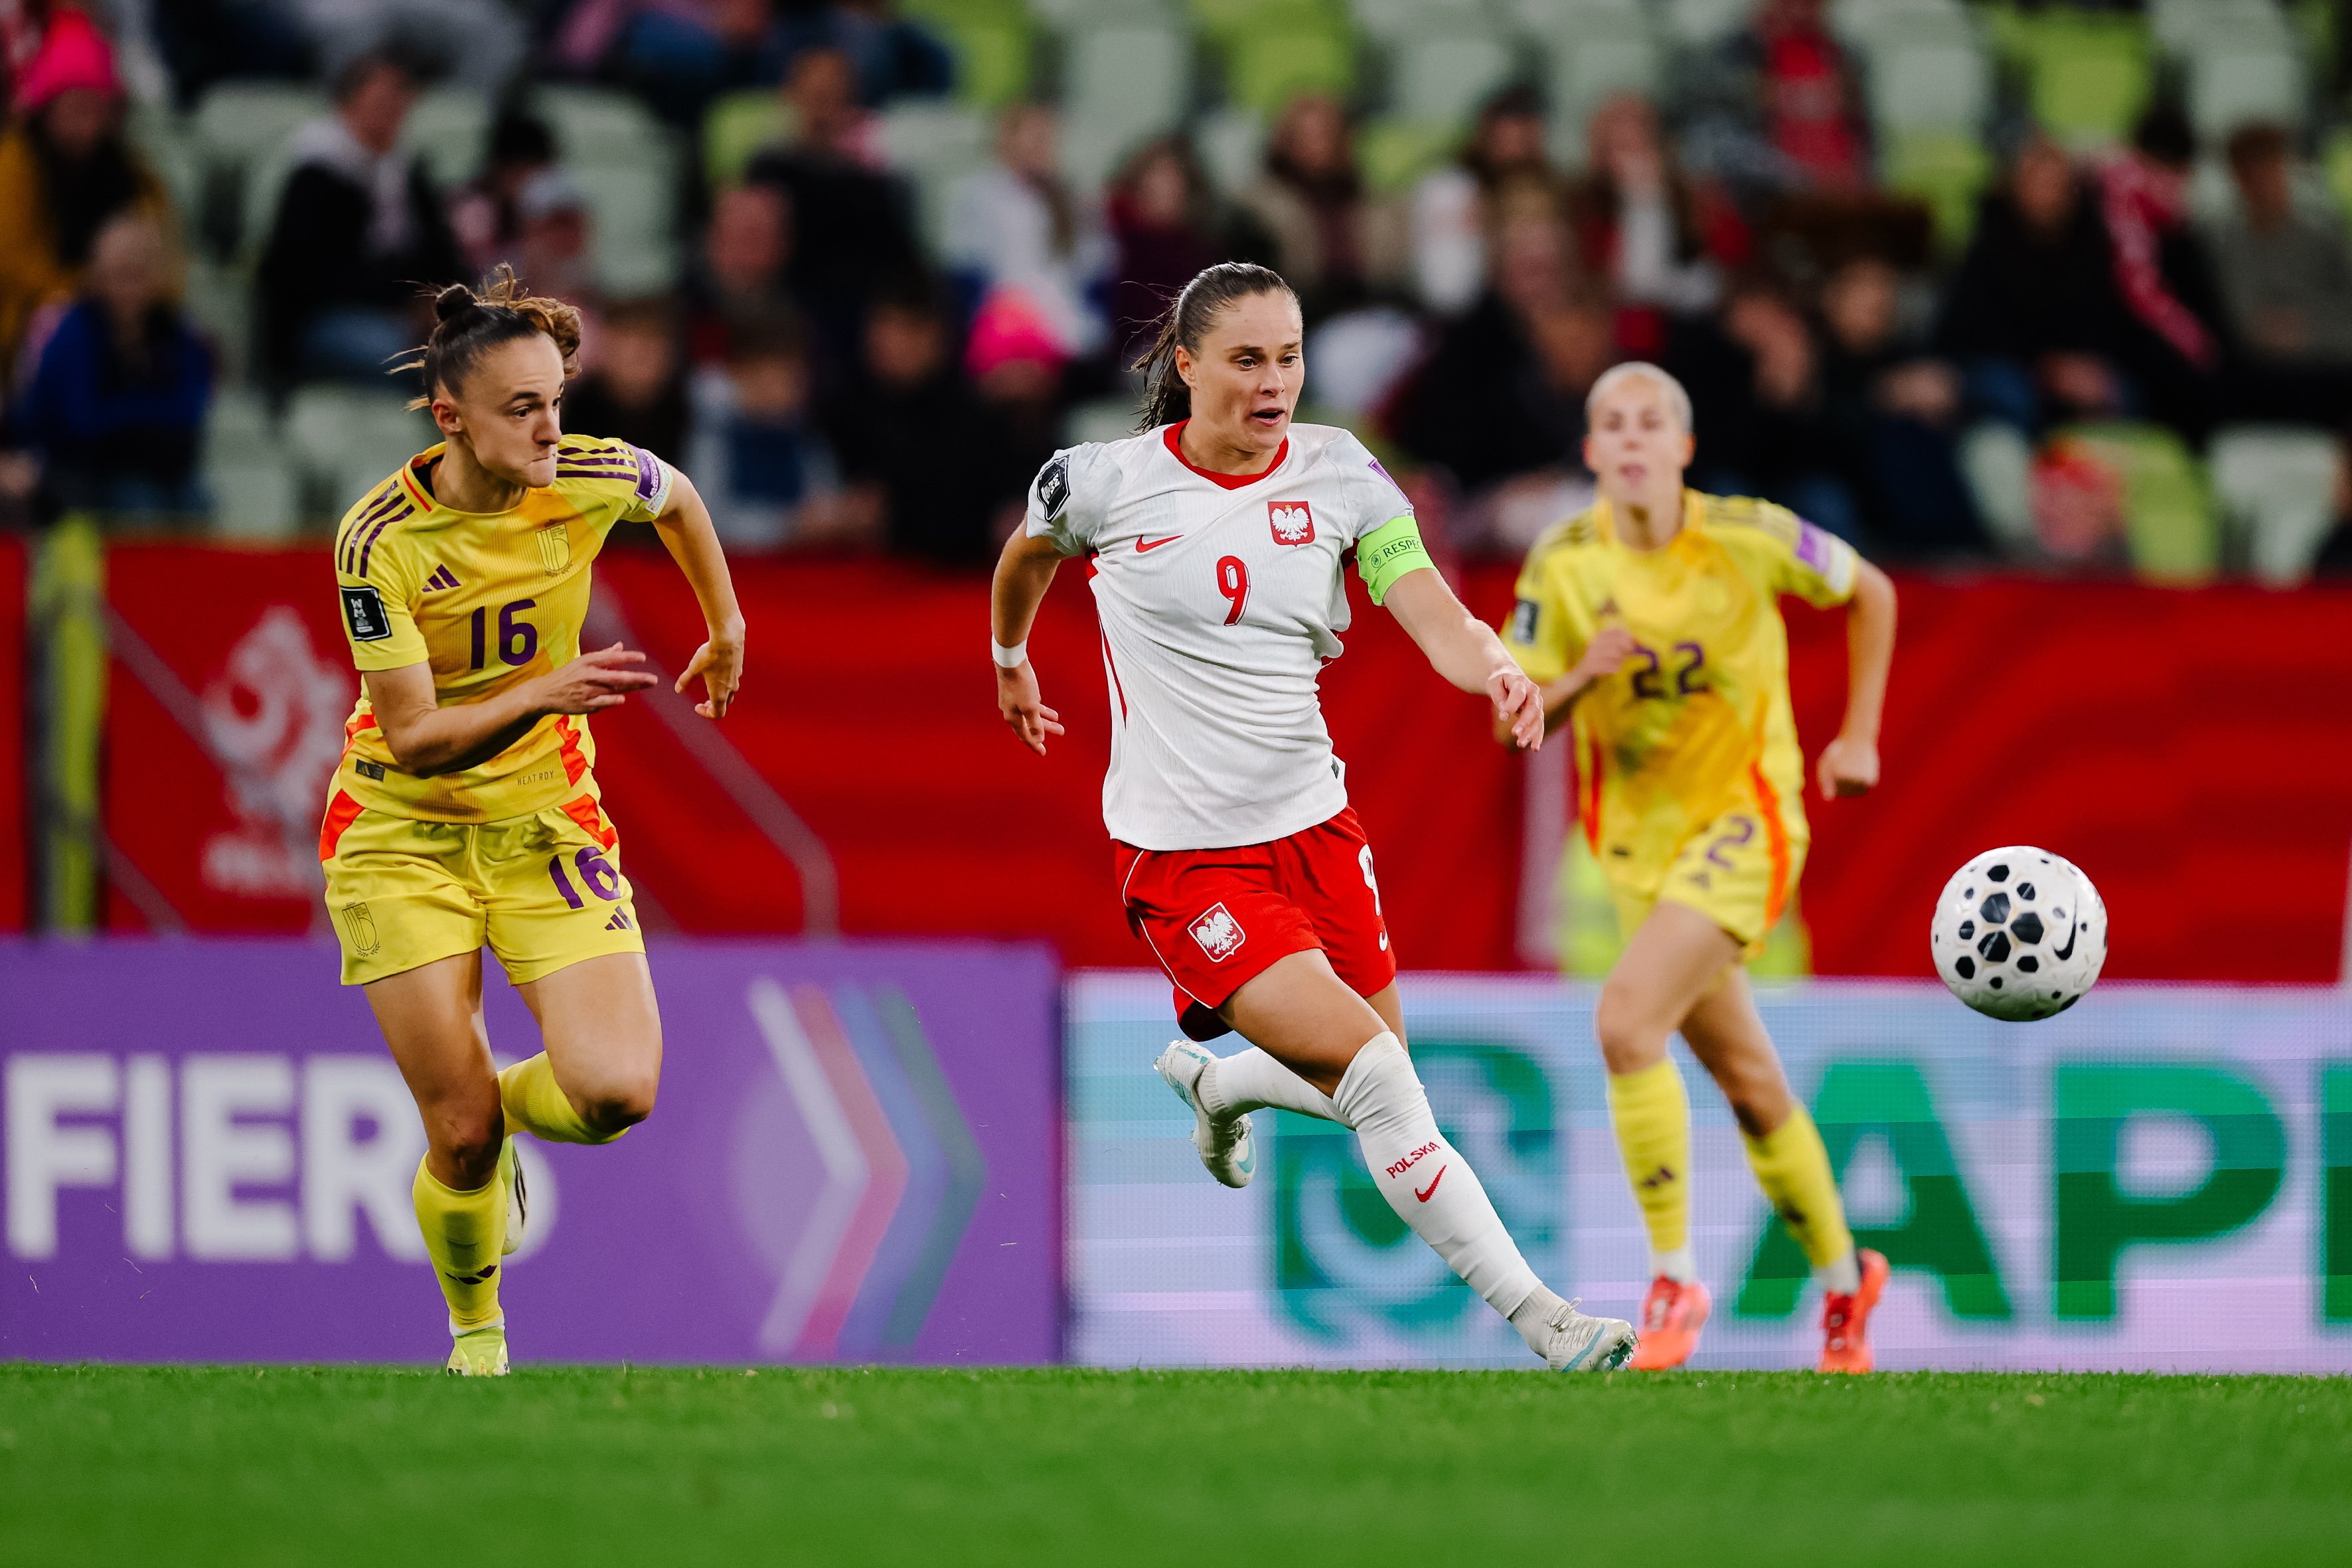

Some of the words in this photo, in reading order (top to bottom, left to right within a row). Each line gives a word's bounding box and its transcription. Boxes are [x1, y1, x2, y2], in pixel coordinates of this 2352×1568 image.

[1217, 555, 1251, 627] 9
[470, 599, 538, 669] 16
[1631, 641, 1711, 699] 22
[549, 846, 621, 909] 16
[1385, 1141, 1441, 1179] POLSKA
[1730, 1053, 2352, 1325] AP
